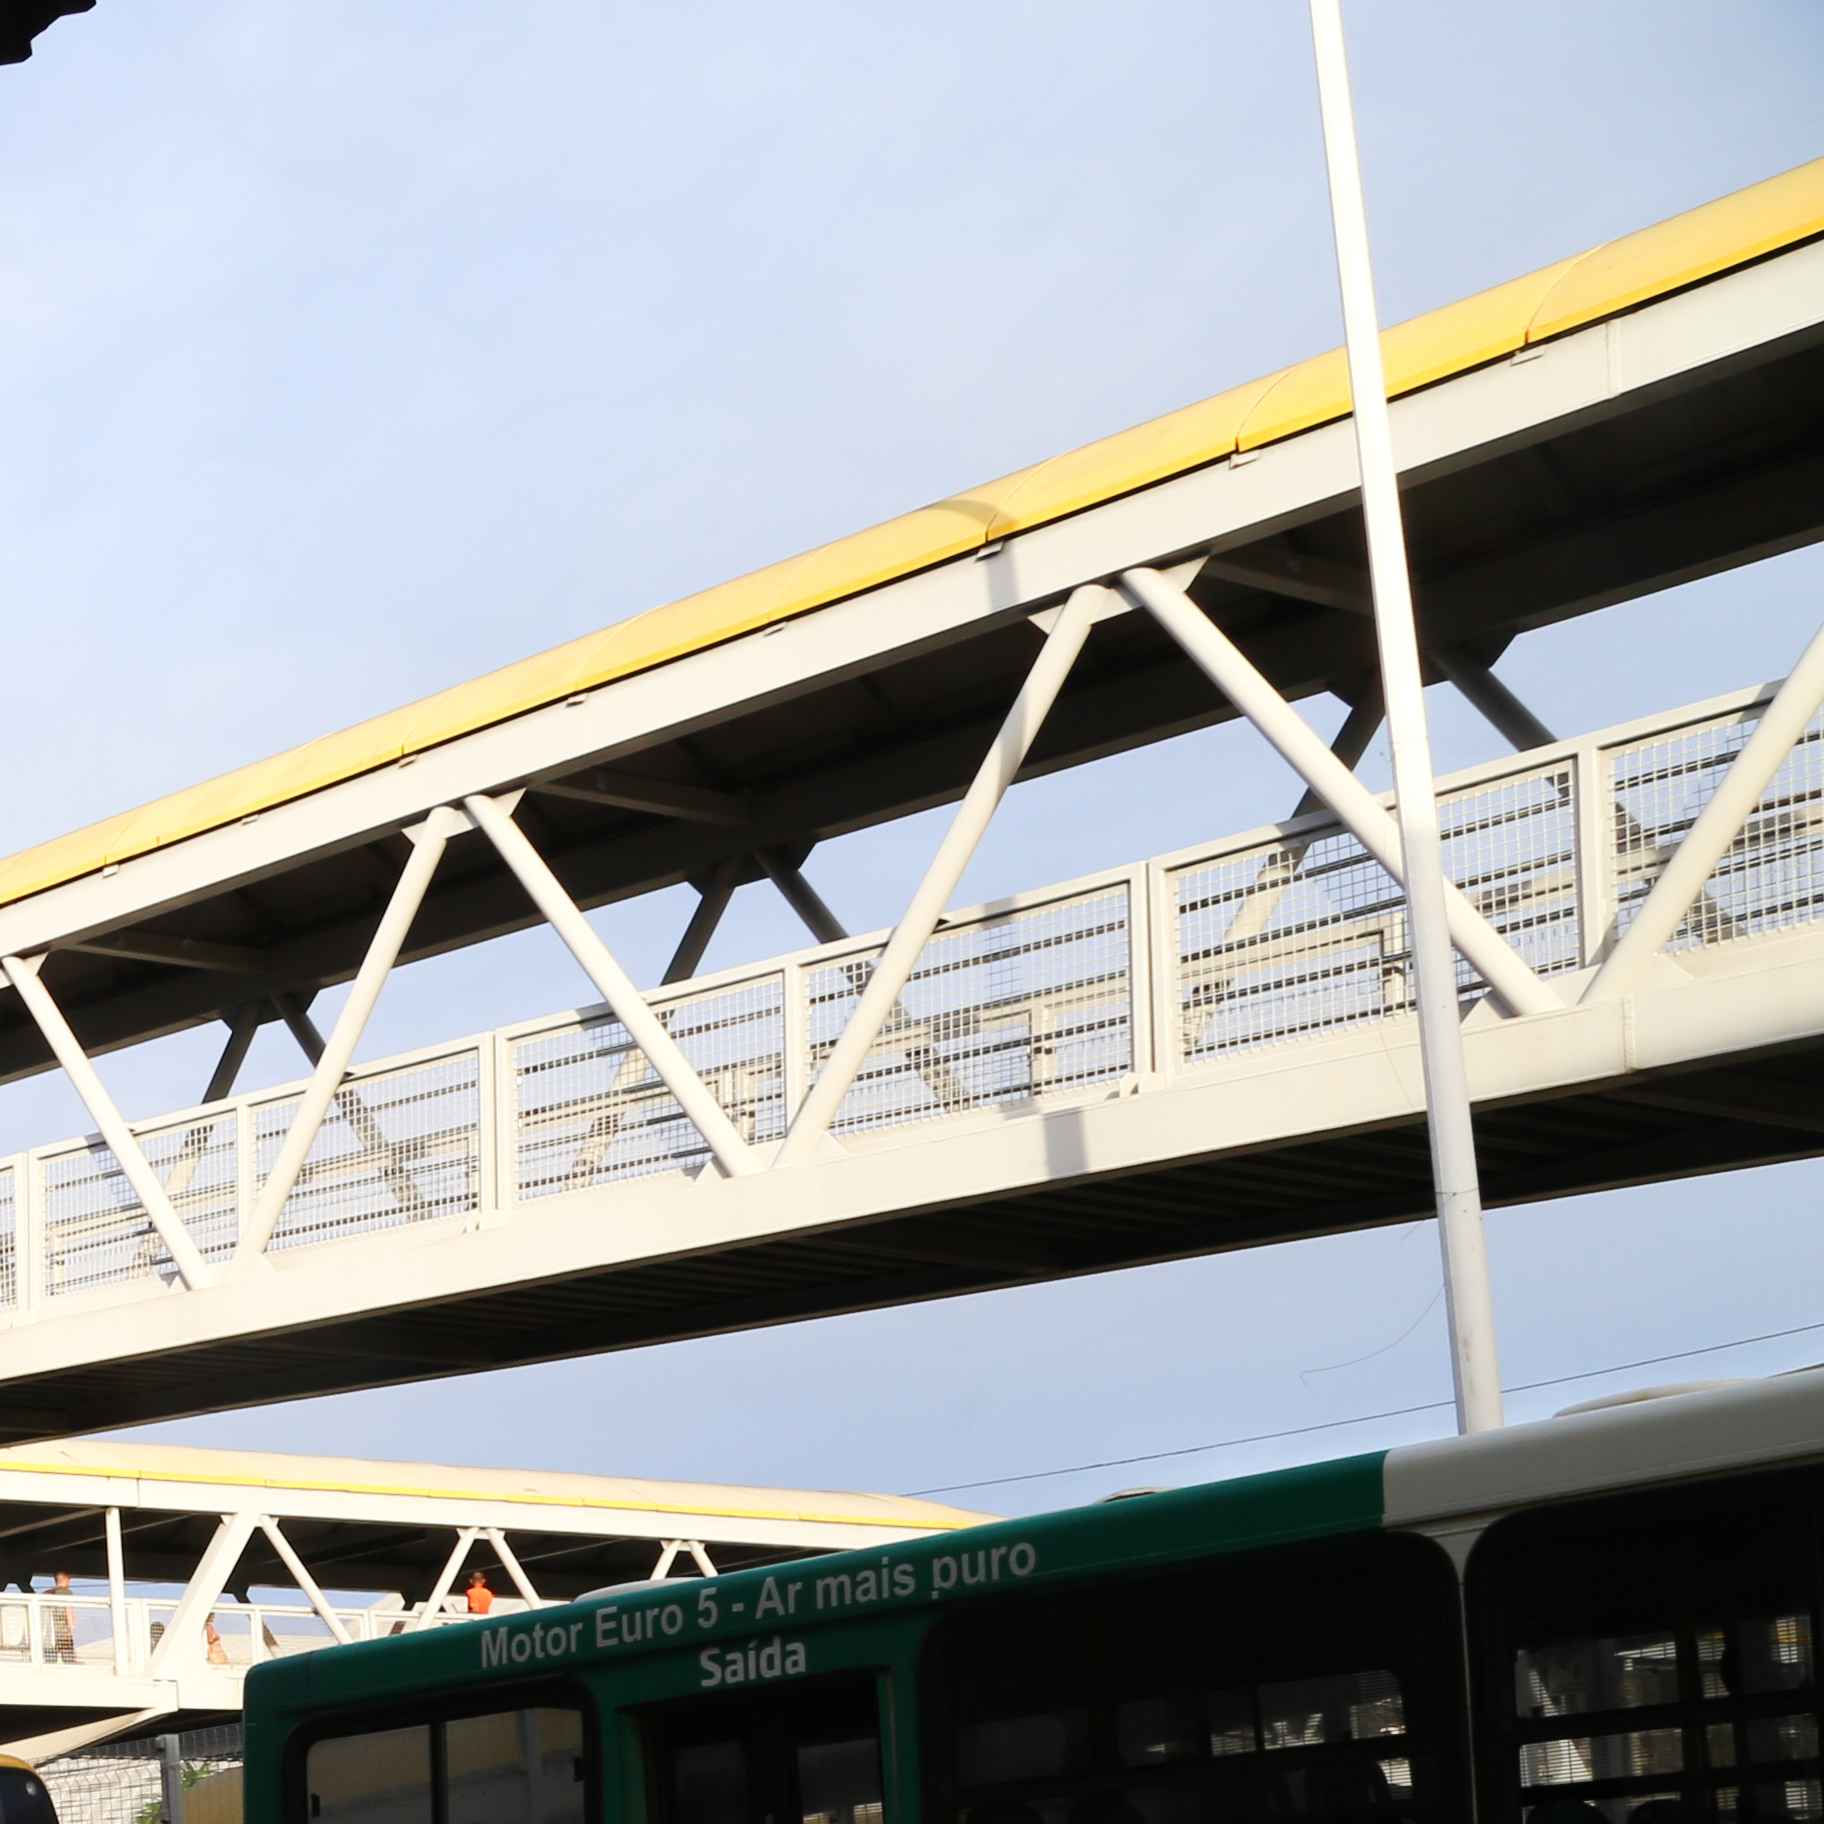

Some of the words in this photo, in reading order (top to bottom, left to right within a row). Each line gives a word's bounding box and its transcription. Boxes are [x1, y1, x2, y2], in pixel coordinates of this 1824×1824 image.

[480, 1618, 584, 1669] Motor
[596, 1604, 683, 1648] Euro
[697, 1588, 718, 1628] 5
[732, 1603, 745, 1612] -
[756, 1577, 802, 1620] Ar
[816, 1555, 915, 1608] mais
[931, 1540, 1037, 1600] puro
[699, 1637, 807, 1687] Saída
